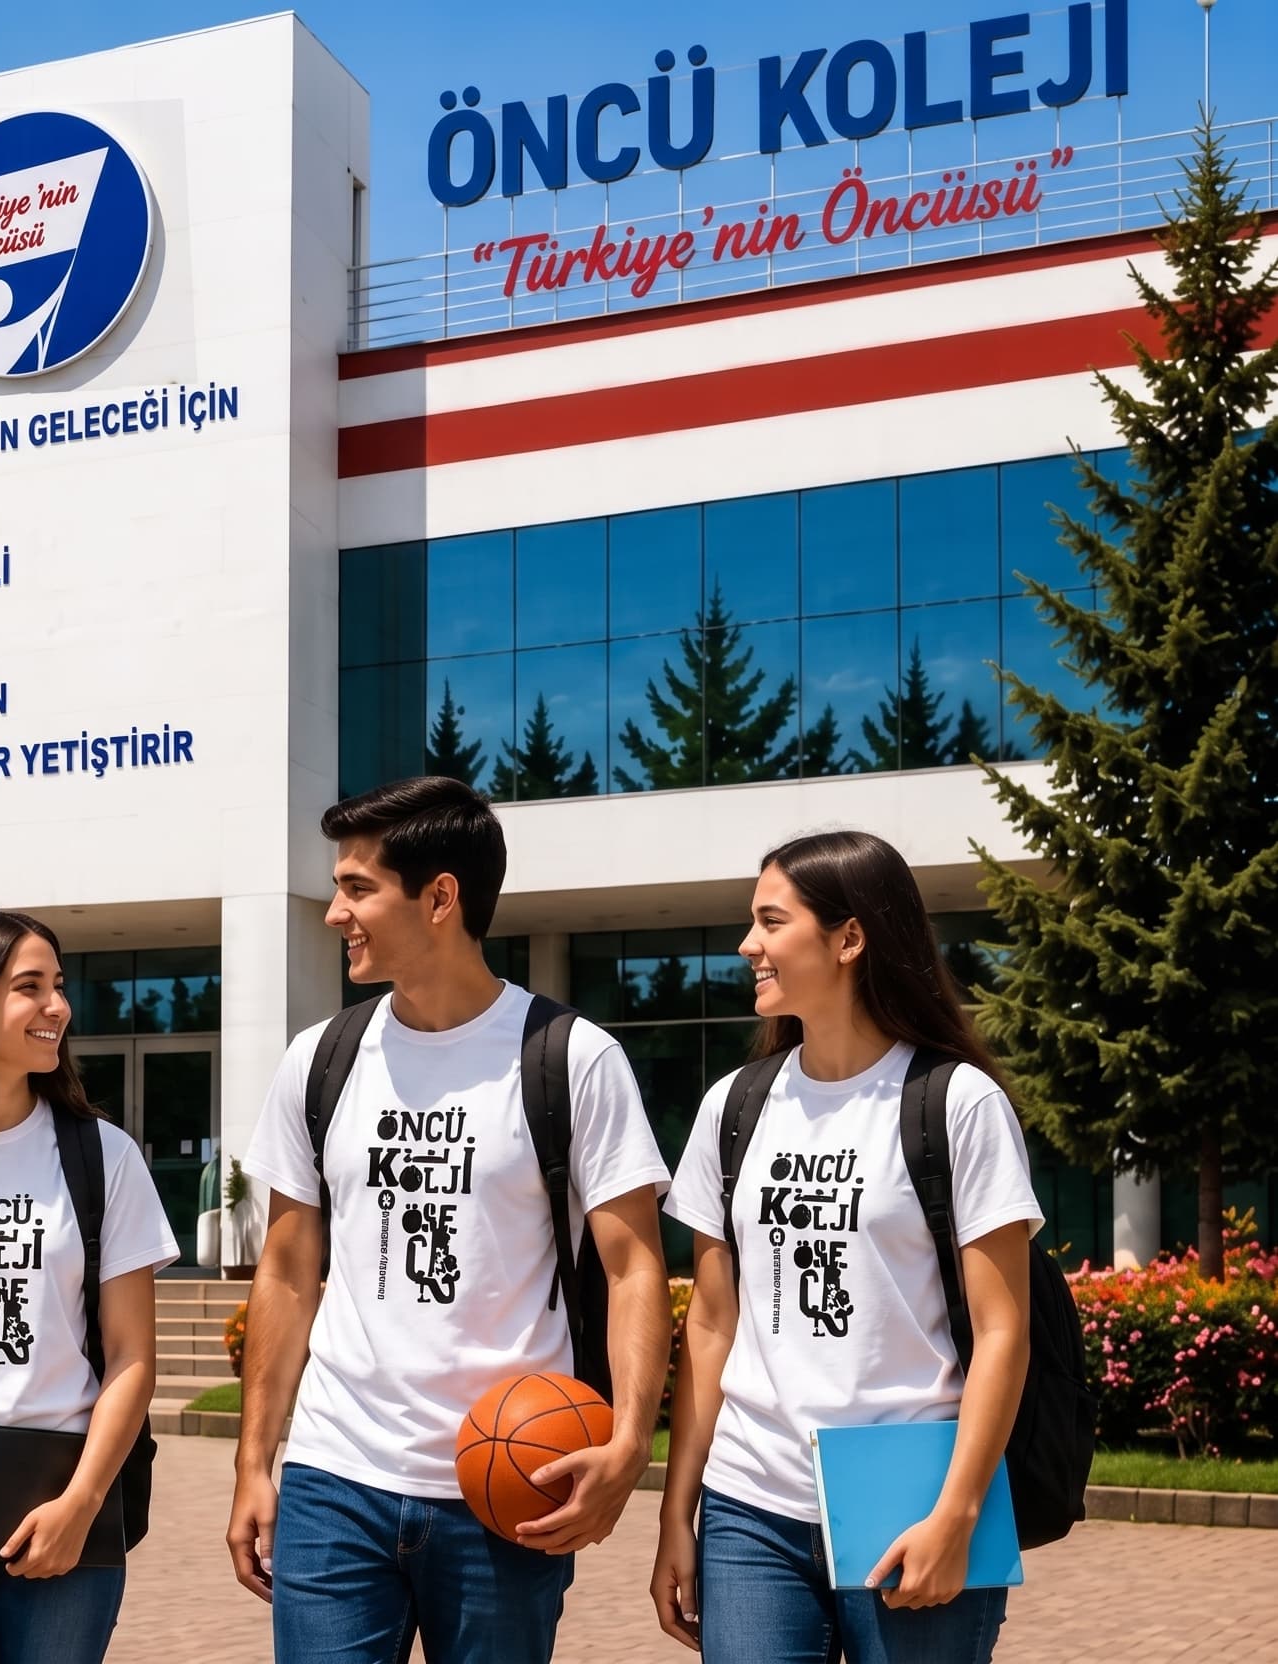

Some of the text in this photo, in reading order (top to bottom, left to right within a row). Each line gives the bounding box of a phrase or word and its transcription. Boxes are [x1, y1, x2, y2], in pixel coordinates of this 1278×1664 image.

[428, 44, 714, 208] ÖNCÜ
[28, 388, 169, 447] GELECEĞİ
[179, 382, 239, 431] İÇİN
[22, 723, 194, 778] YETİŞTİRİR
[377, 1106, 467, 1143] ÖNCÜ
[770, 1149, 857, 1183] ÖNCÜ
